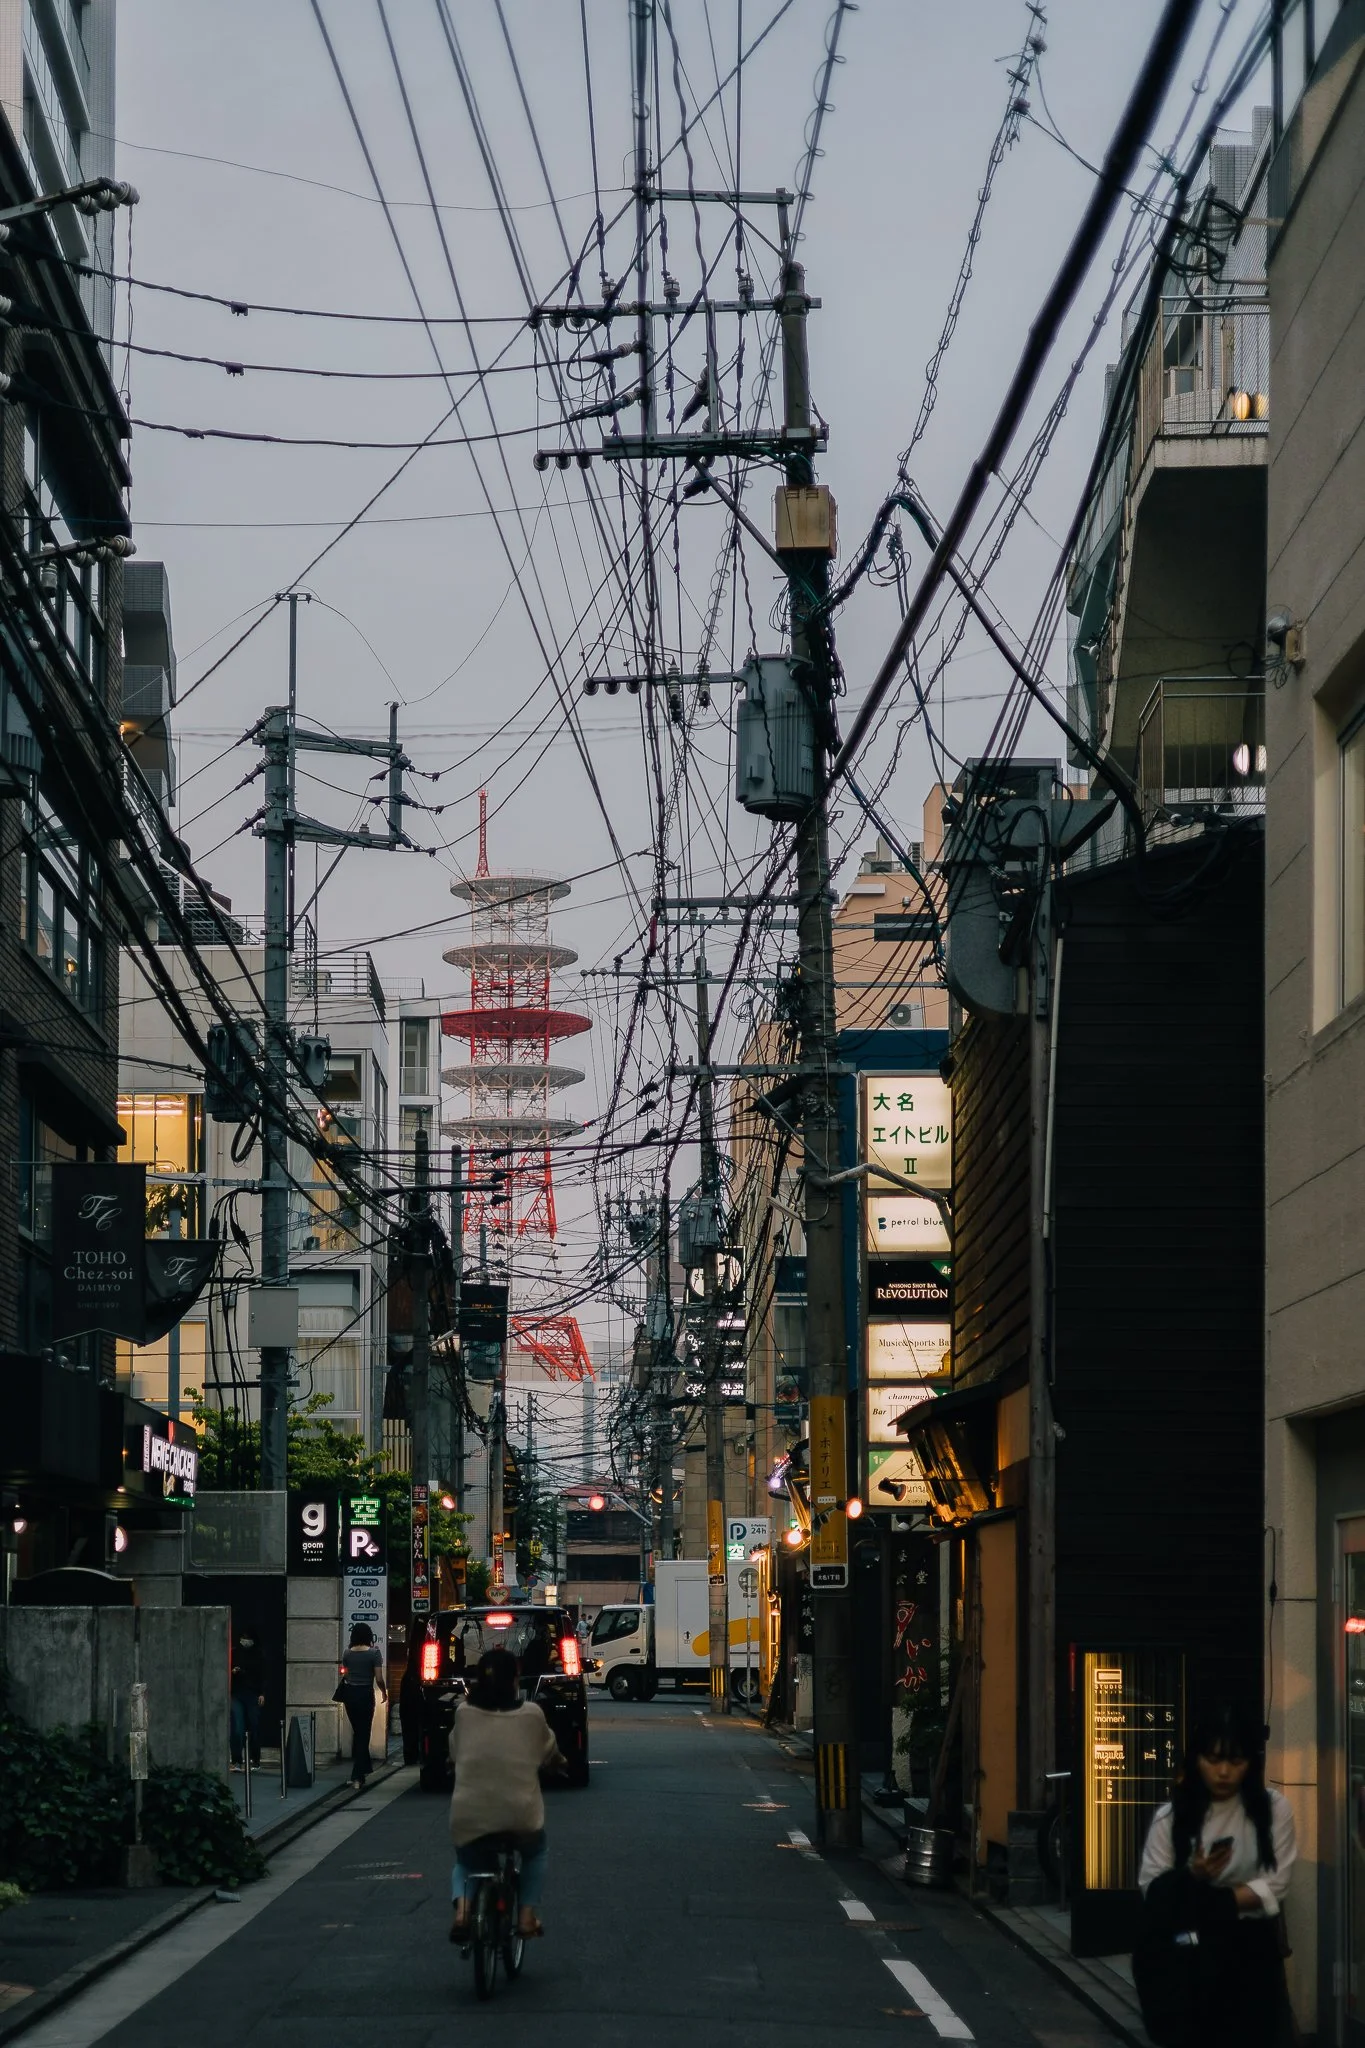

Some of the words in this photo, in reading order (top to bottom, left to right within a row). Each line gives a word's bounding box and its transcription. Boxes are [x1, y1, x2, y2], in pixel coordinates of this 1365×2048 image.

[873, 1092, 914, 1111] 大名
[872, 1125, 949, 1144] エイトビル
[891, 1218, 919, 1228] petrol
[924, 1217, 944, 1226] blue
[73, 1251, 126, 1265] TOHO
[63, 1266, 134, 1280] Chez-soi
[942, 1266, 952, 1275] 4F
[77, 1284, 121, 1292] DAIMYO
[877, 1288, 948, 1299] REVOLUTION
[872, 1408, 887, 1416] Bar
[873, 1455, 885, 1464] 1F
[350, 1496, 380, 1526] 空
[302, 1503, 325, 1537] g
[302, 1542, 324, 1550] goom
[351, 1531, 369, 1557] P
[358, 1599, 384, 1609] 200円
[1094, 1715, 1126, 1723] moment
